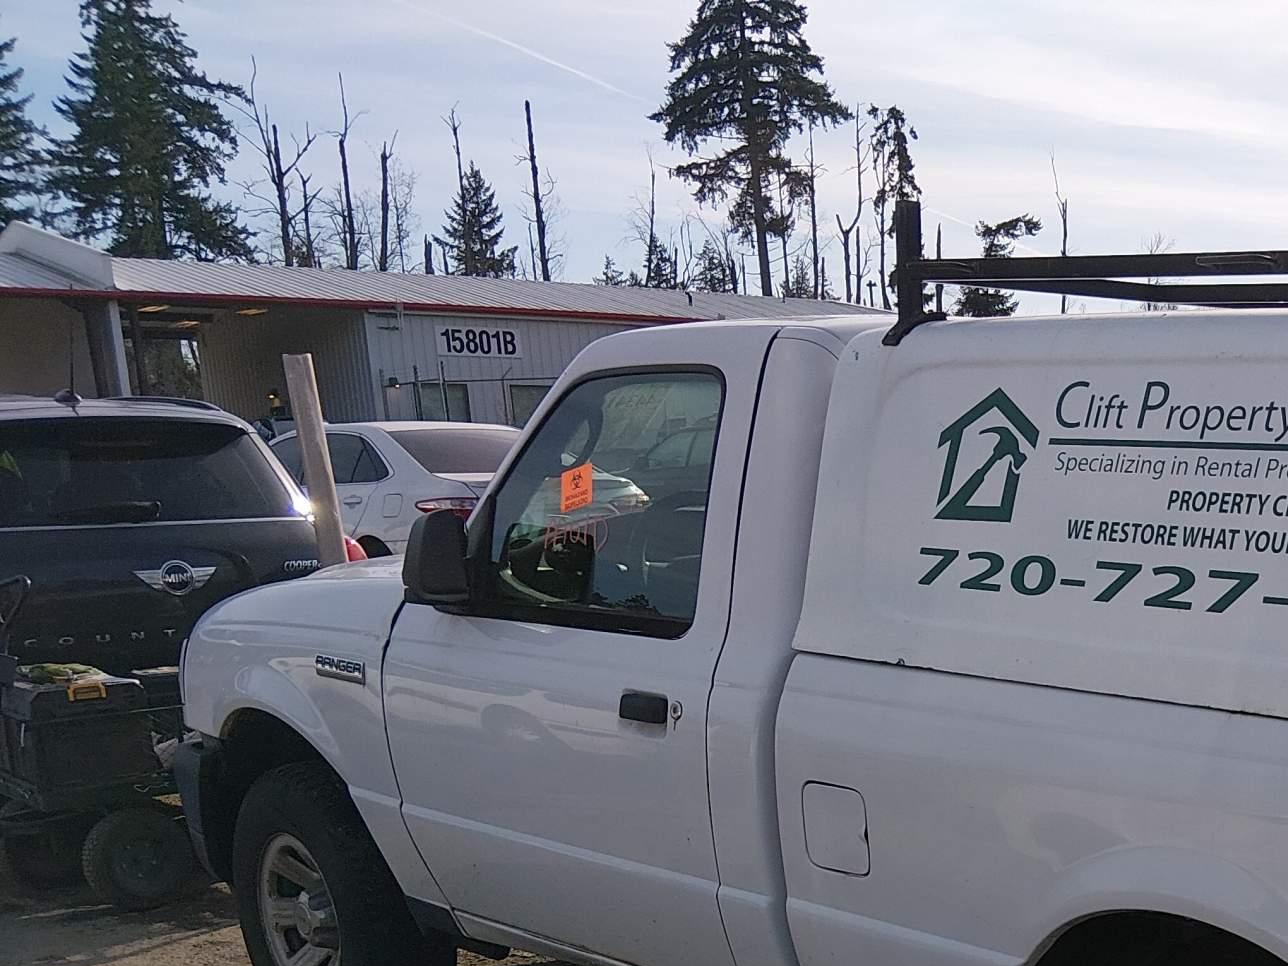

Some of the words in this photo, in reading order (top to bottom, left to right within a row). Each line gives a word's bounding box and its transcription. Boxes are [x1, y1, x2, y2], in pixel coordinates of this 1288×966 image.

[440, 328, 517, 355] 15801B
[1056, 381, 1128, 429] Clift
[1055, 451, 1166, 480] Specializing
[1170, 455, 1189, 476] in
[1194, 456, 1261, 479] Rental
[1167, 490, 1271, 516] PROPERTY
[1067, 519, 1094, 541] WE
[1097, 521, 1179, 547] RESTORE
[1182, 526, 1240, 551] WHAT
[163, 572, 191, 583] MINI
[284, 559, 318, 571] COOPER
[315, 655, 362, 675] RANGER
